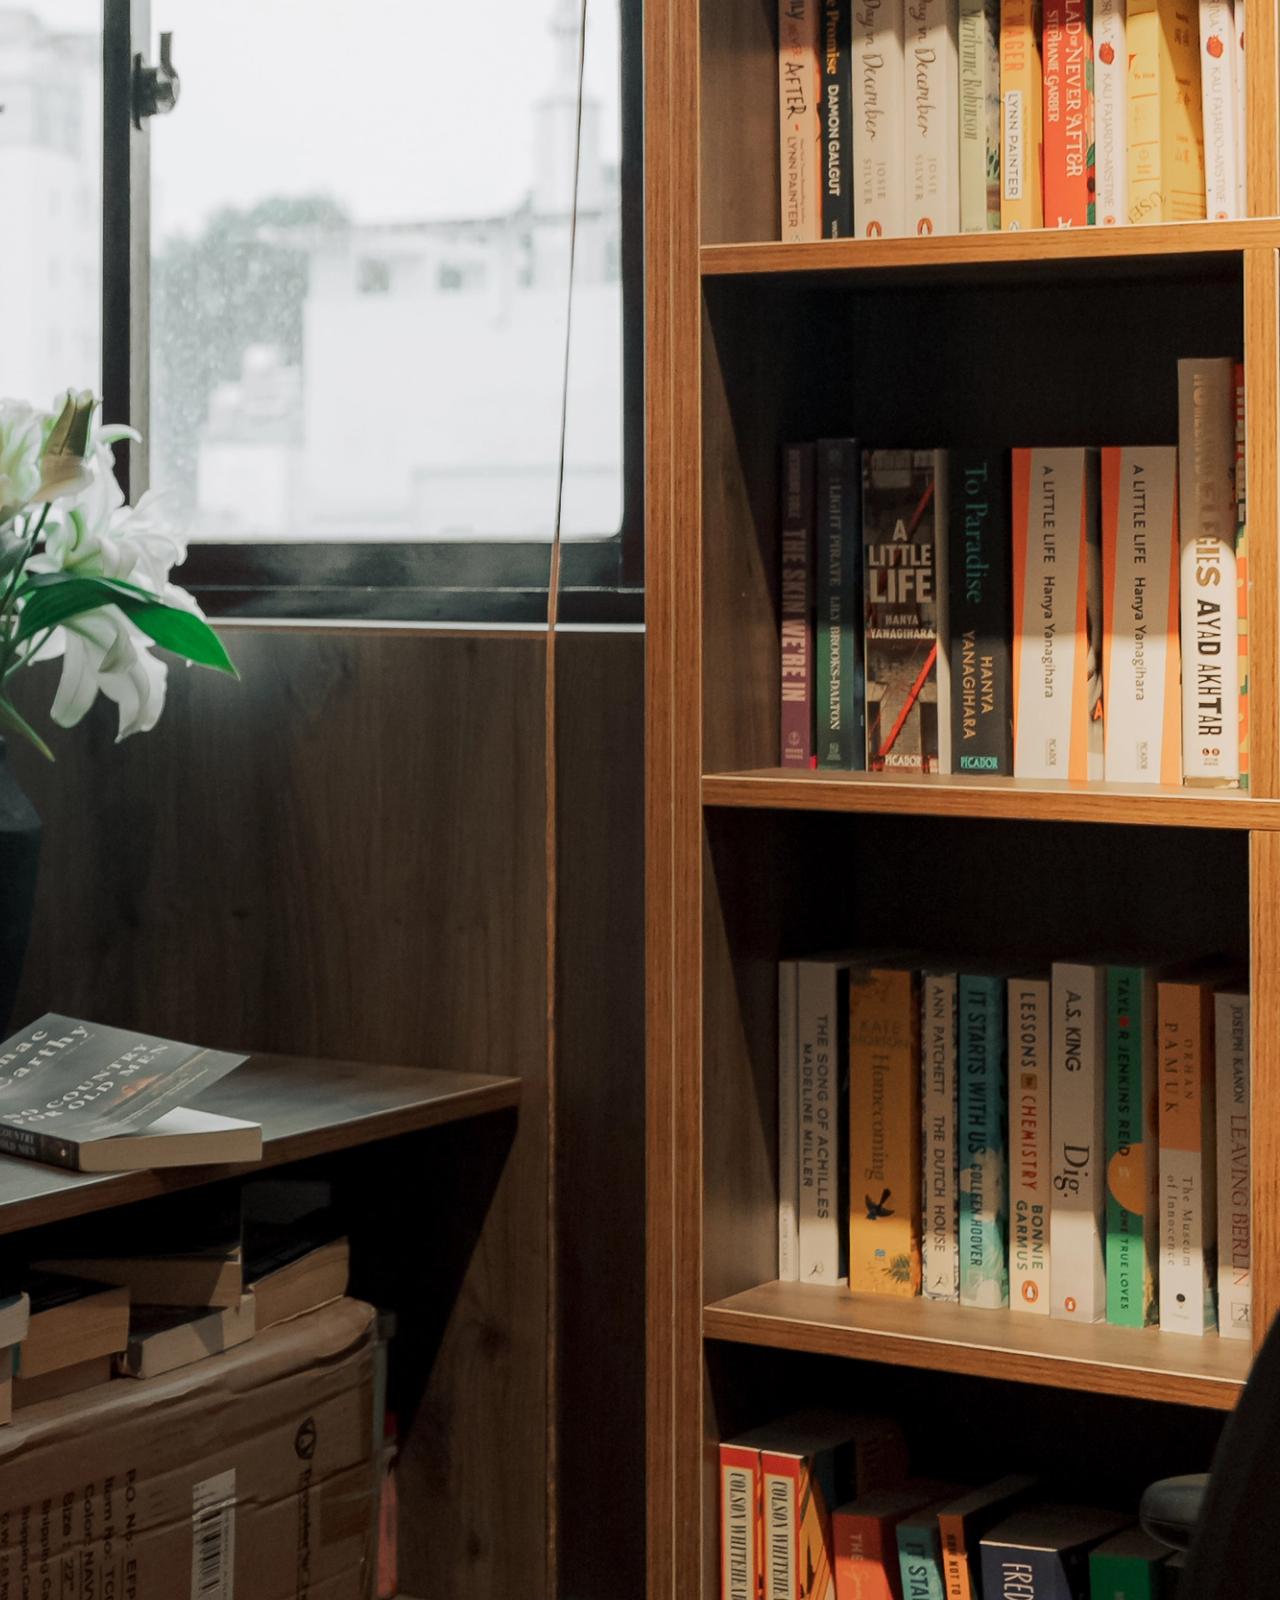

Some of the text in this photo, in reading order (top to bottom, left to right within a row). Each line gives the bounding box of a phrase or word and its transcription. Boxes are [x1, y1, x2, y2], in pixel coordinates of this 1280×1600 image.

[827, 85, 838, 138] DAMON
[1005, 92, 1019, 198] LYNN PAINTER
[868, 543, 932, 568] LITTLE
[892, 518, 908, 542] A
[964, 462, 991, 605] To Paradise
[870, 568, 933, 604] LIFE
[1132, 481, 1147, 701] LITTLE LIFE Hanya Yanagihara
[960, 630, 977, 740] YANAGIHARA
[980, 656, 994, 715] HANYA
[1197, 599, 1223, 737] AYAD AKHTAR
[967, 1010, 987, 1157] STARTS WITH US
[1065, 1026, 1081, 1073] KING
[1163, 1022, 1180, 1113] PAMUK
[68, 1081, 115, 1111] OLD
[803, 1043, 814, 1188] MADELINE MILLER
[816, 1015, 829, 1219] THE SONG OF ACHILLES
[932, 985, 946, 1253] ANN PATCHETT THE DUTCH HOUSE
[1053, 1141, 1090, 1198] Dig.
[770, 1480, 789, 1527] COLSON
